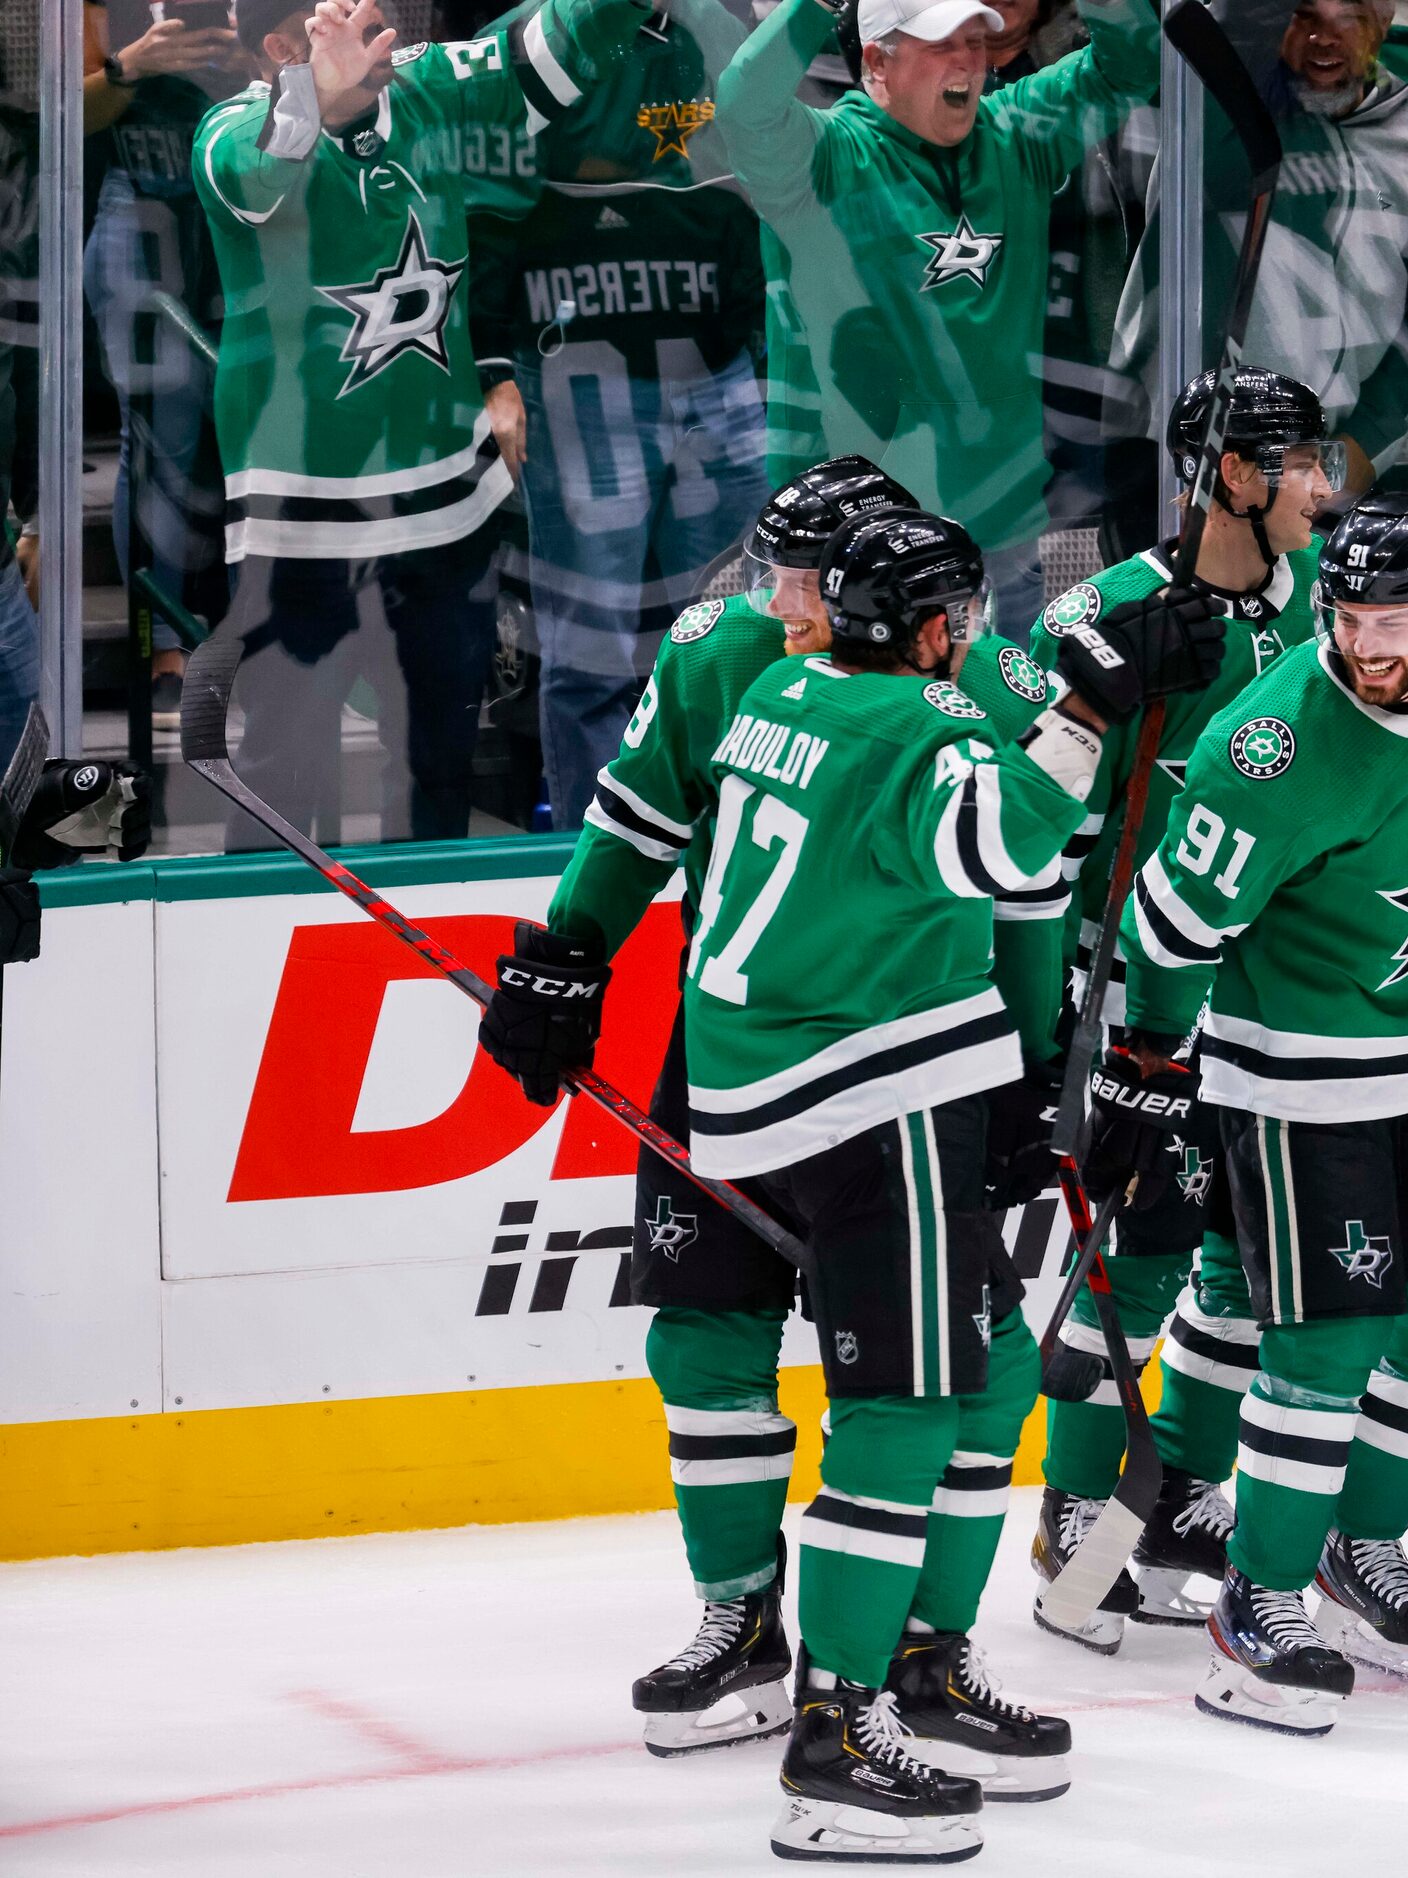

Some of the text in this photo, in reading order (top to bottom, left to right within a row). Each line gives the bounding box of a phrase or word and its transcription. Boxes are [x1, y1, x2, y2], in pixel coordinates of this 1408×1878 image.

[637, 101, 716, 127] STARS
[858, 495, 886, 506] ENERGY
[756, 524, 779, 545] CCM
[911, 535, 945, 549] TRANSFER
[1346, 543, 1371, 568] 91
[826, 567, 846, 594] 47
[1060, 726, 1098, 755] CCM
[1247, 720, 1290, 759] DALLAS
[1234, 741, 1273, 775] STARS
[1176, 803, 1257, 899] 91
[501, 966, 600, 998] CCM
[855, 1768, 893, 1787] BAUER
